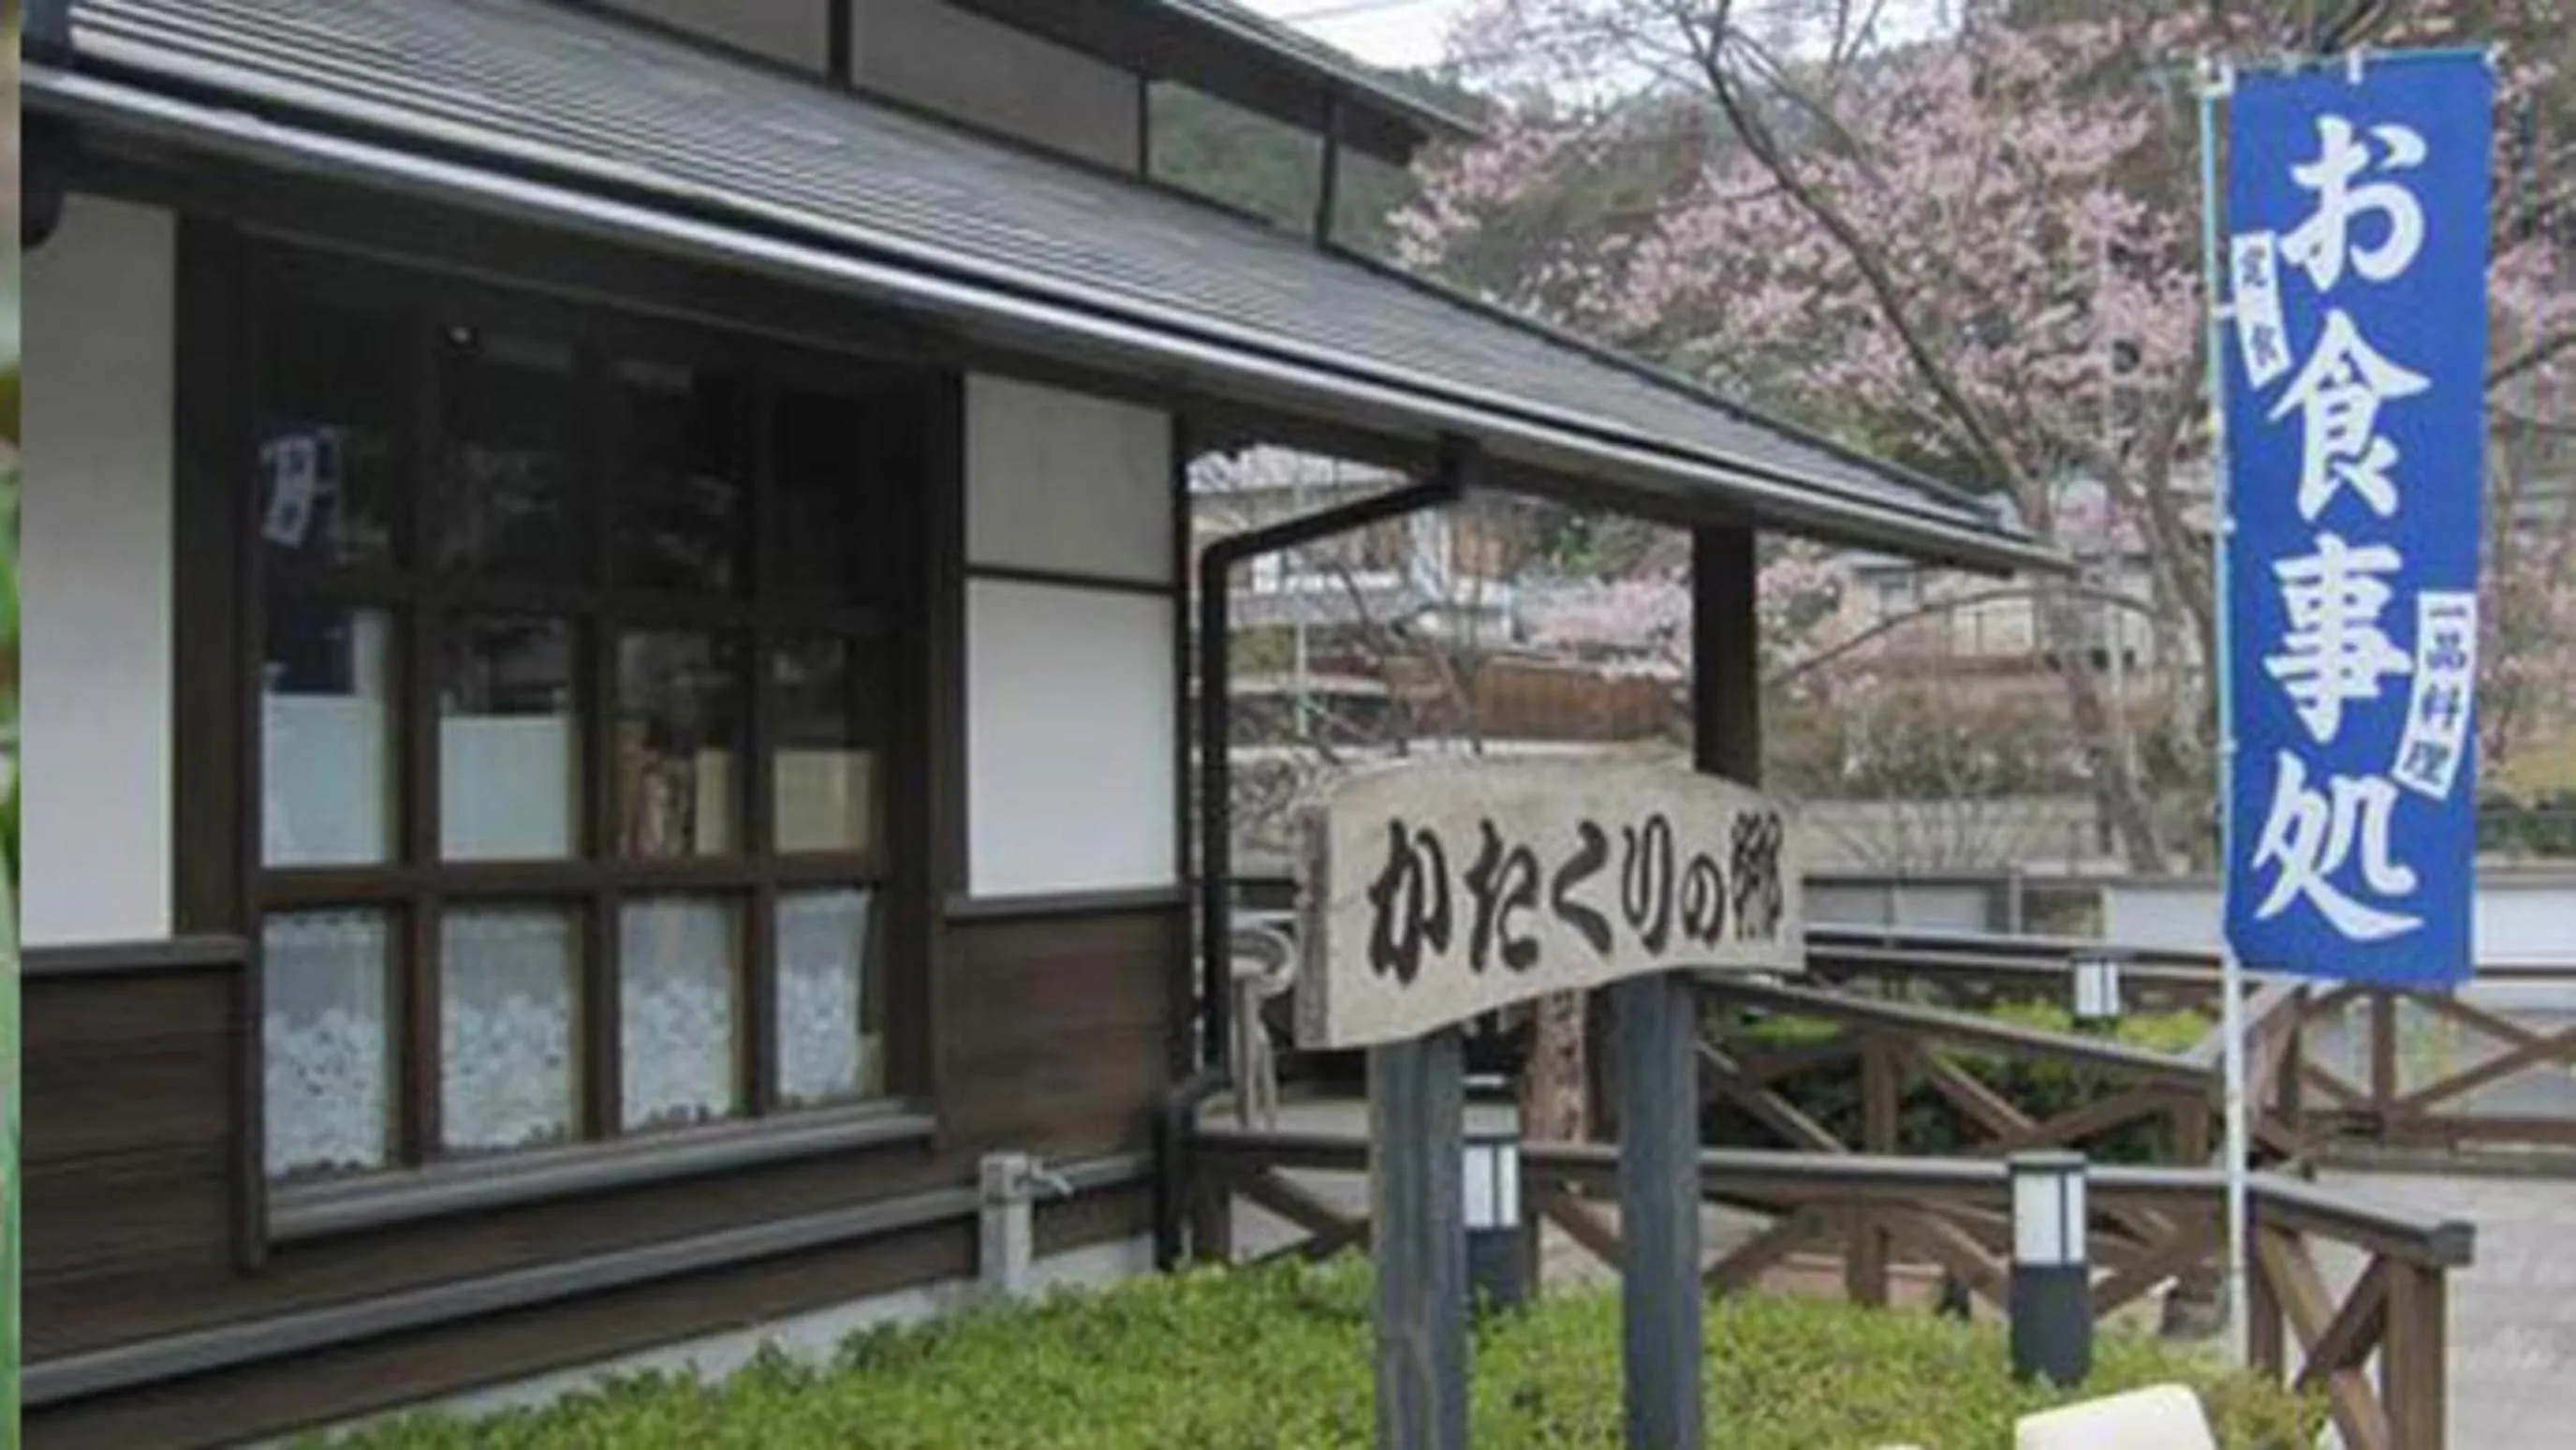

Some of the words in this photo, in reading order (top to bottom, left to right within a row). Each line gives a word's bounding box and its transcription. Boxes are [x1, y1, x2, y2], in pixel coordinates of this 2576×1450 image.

[2255, 114, 2431, 941] お食事処
[2403, 605, 2468, 786] 一品料理
